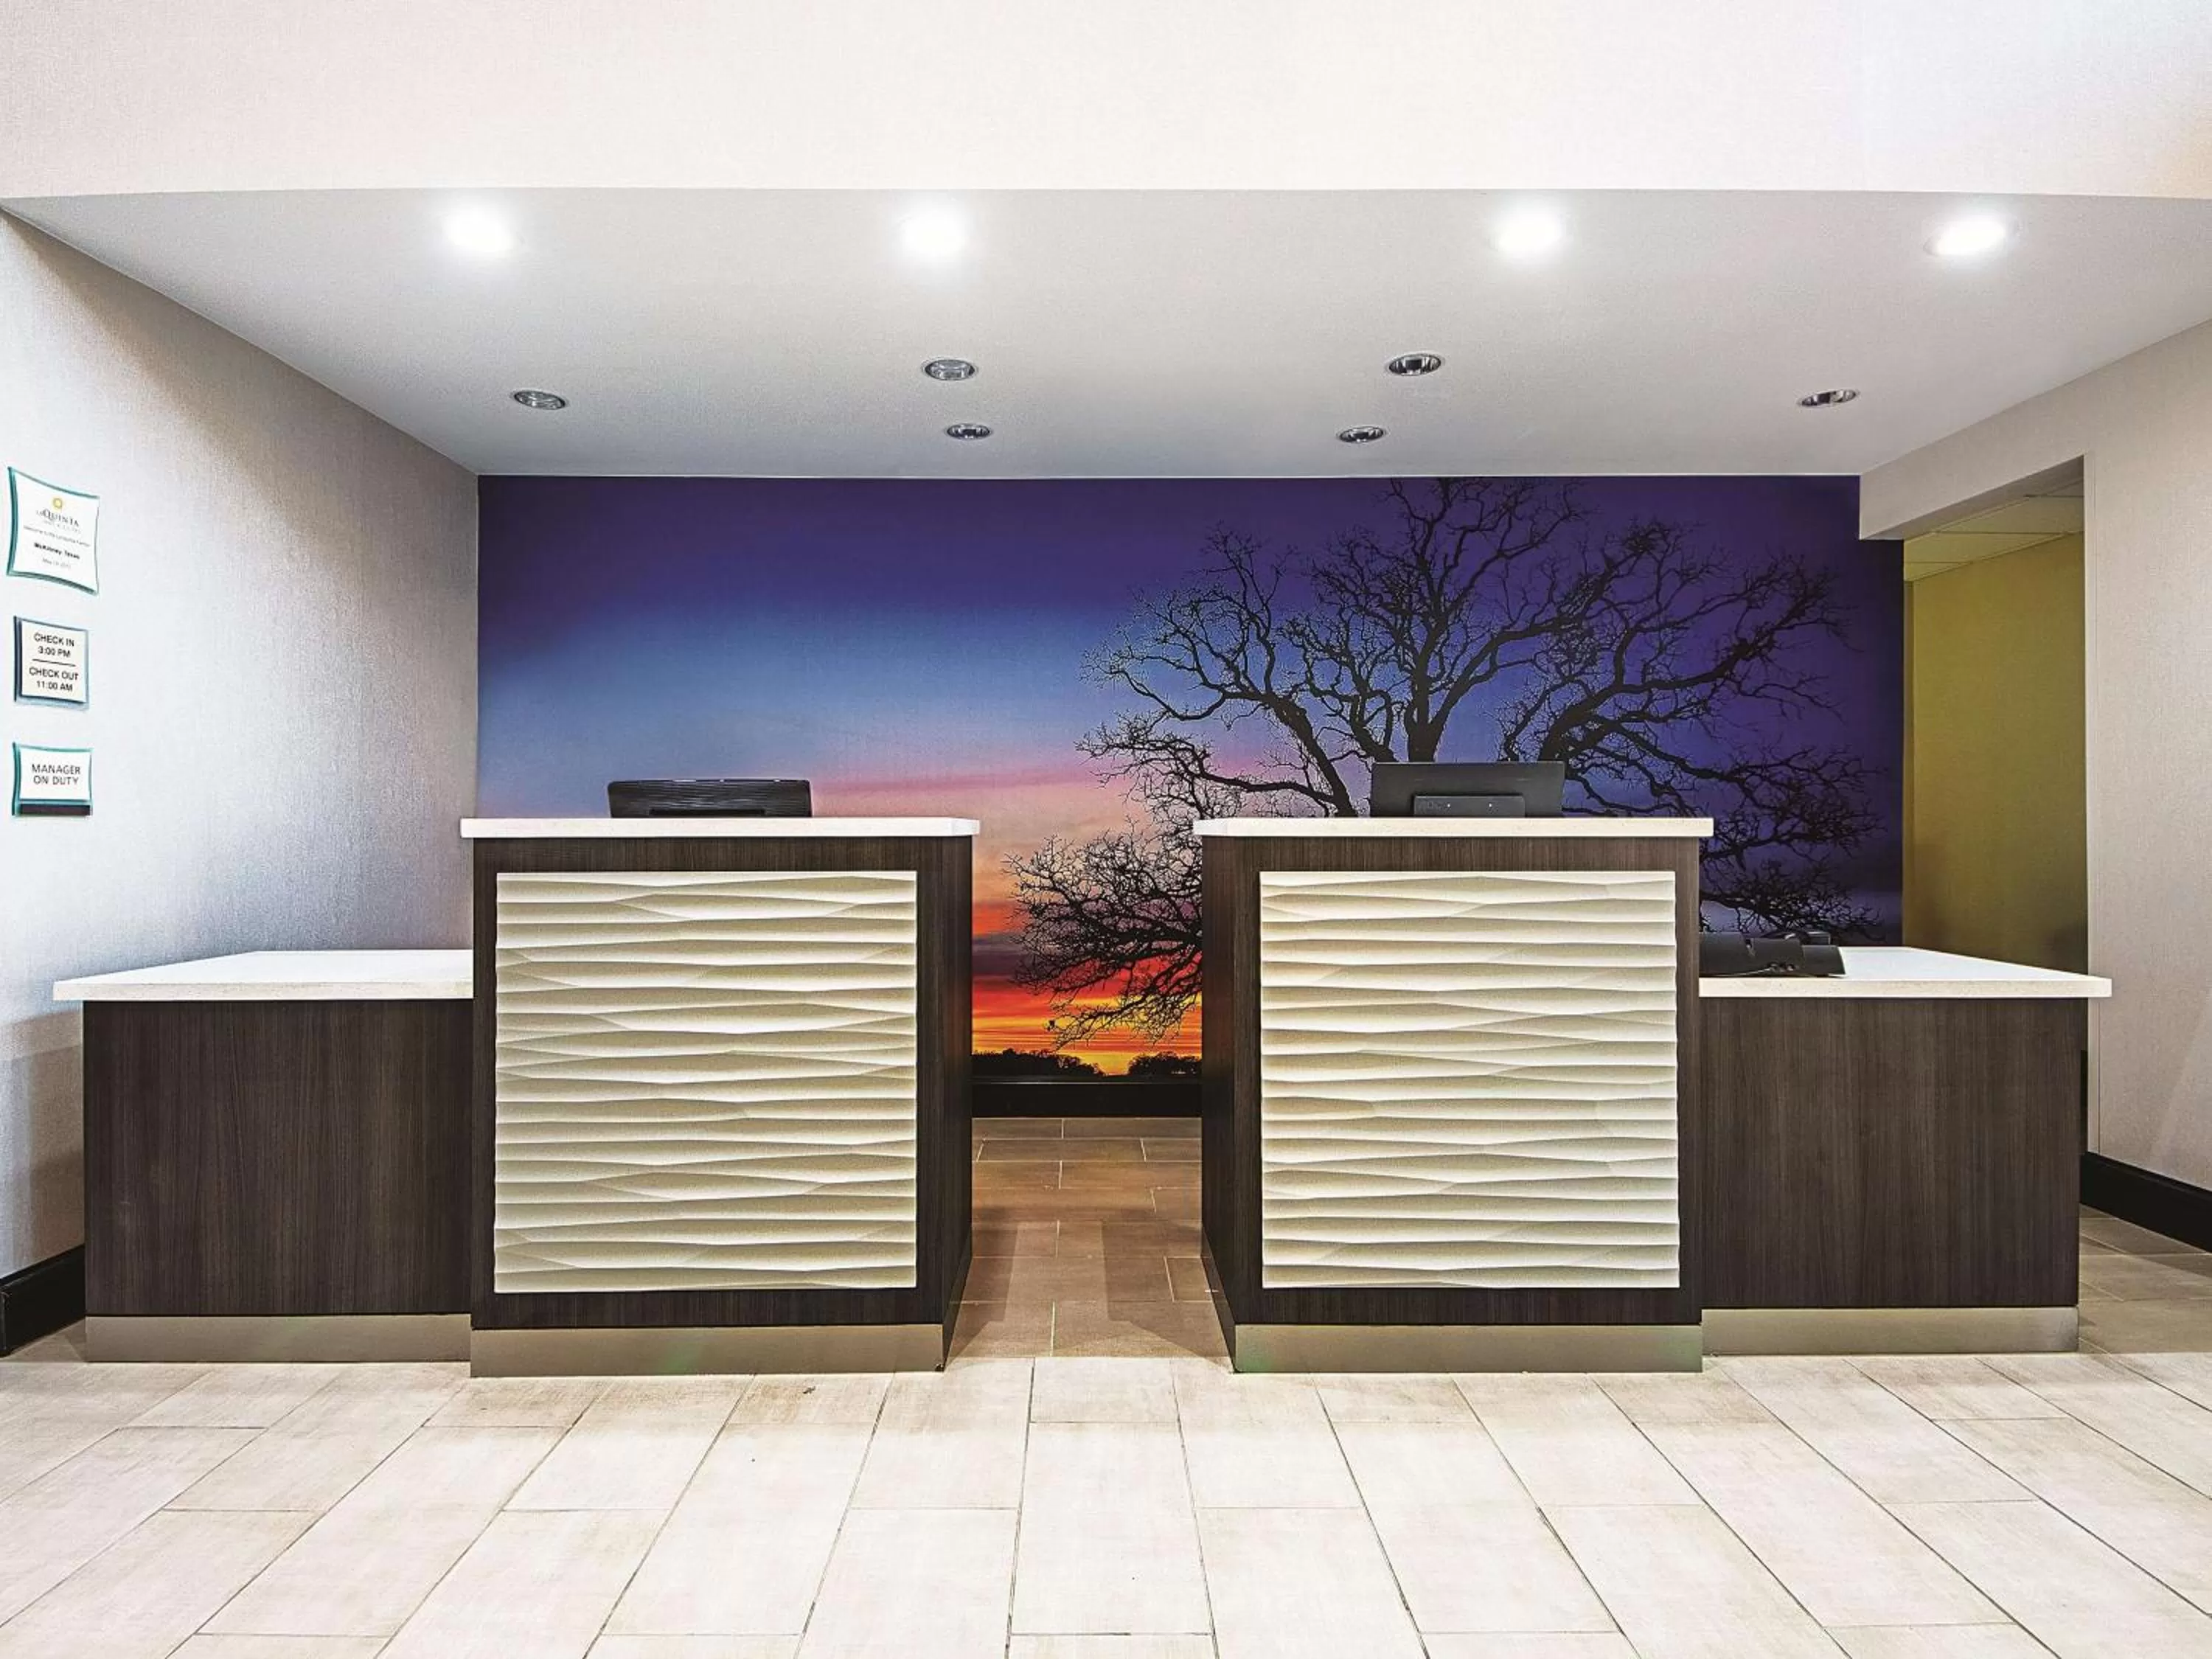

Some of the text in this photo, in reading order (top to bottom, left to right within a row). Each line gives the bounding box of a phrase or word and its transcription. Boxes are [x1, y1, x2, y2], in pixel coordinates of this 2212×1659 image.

[34, 633, 74, 647] CHECK IN
[38, 646, 71, 658] 3:00 PM
[29, 666, 79, 681] CHECK OUT
[36, 681, 73, 692] 11:00 AM
[32, 763, 80, 775] MANAGER
[33, 775, 78, 785] ON DUTY
